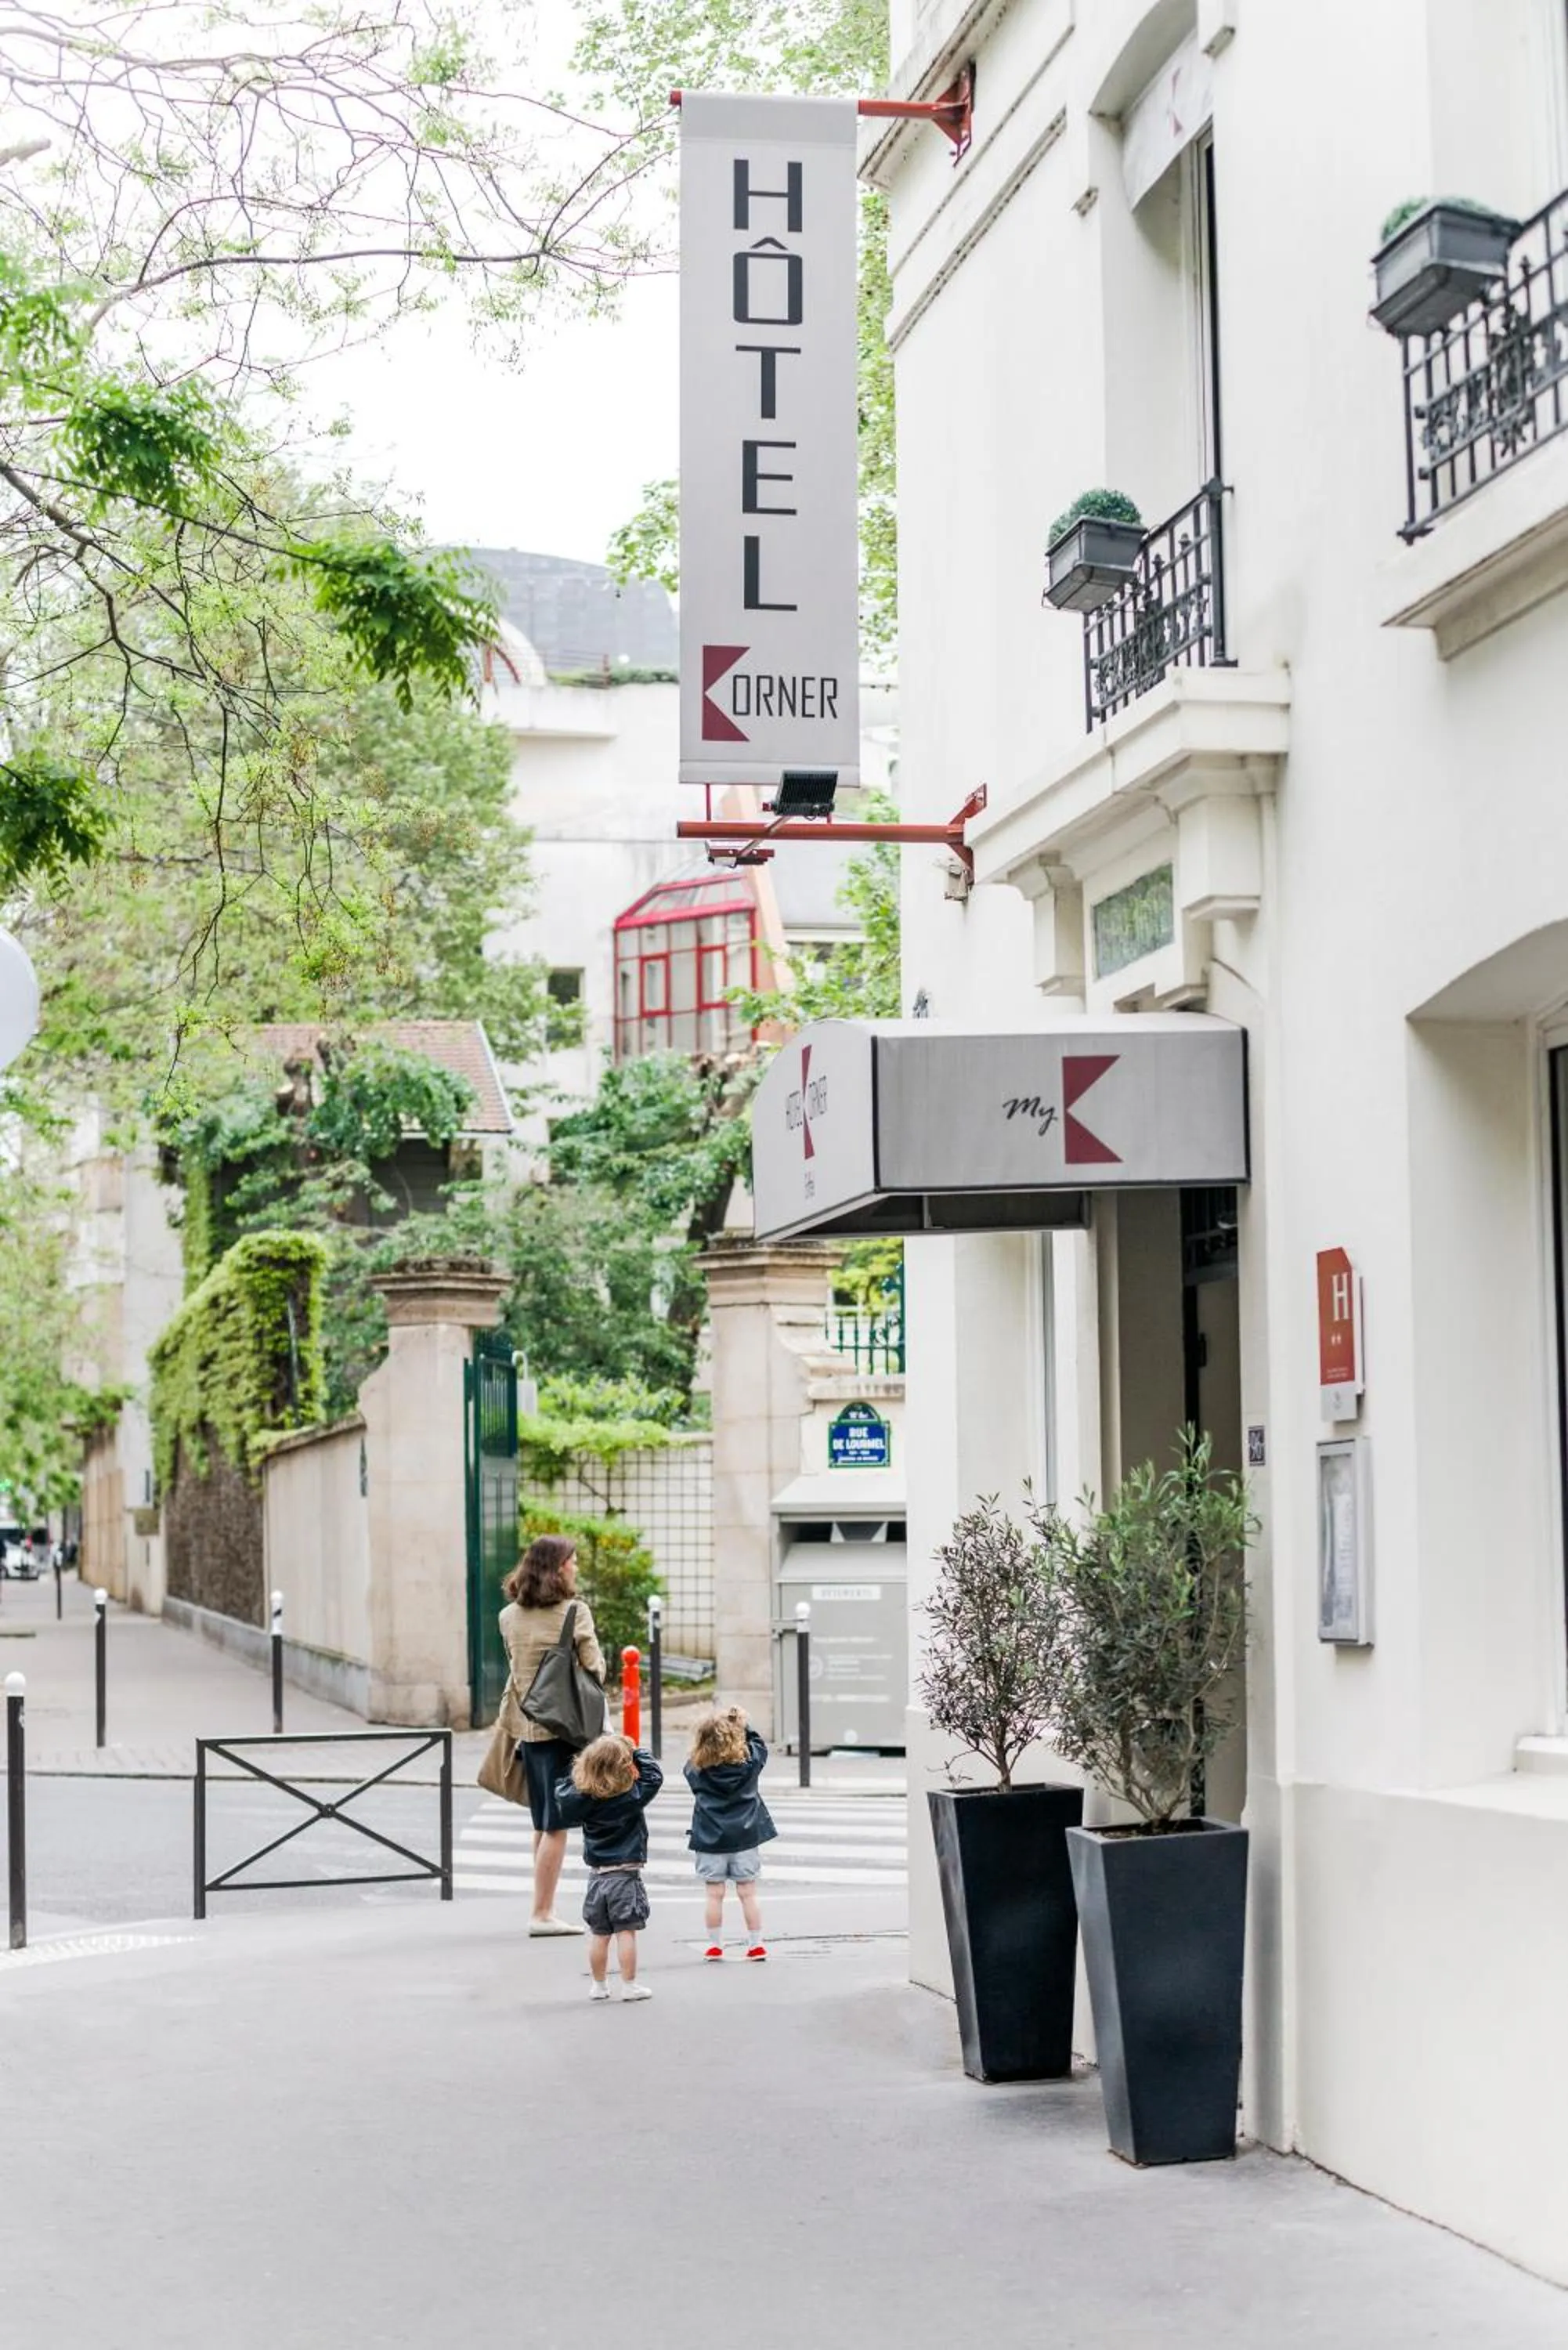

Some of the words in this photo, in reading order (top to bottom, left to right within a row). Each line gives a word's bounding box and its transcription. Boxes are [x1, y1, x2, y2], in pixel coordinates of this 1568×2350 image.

[733, 159, 803, 612] HÔTEL
[1002, 1096, 1058, 1137] My
[1331, 1271, 1349, 1321] H
[833, 1438, 845, 1450] DE
[846, 1438, 885, 1450] LOURMEL
[848, 1426, 869, 1437] RUE
